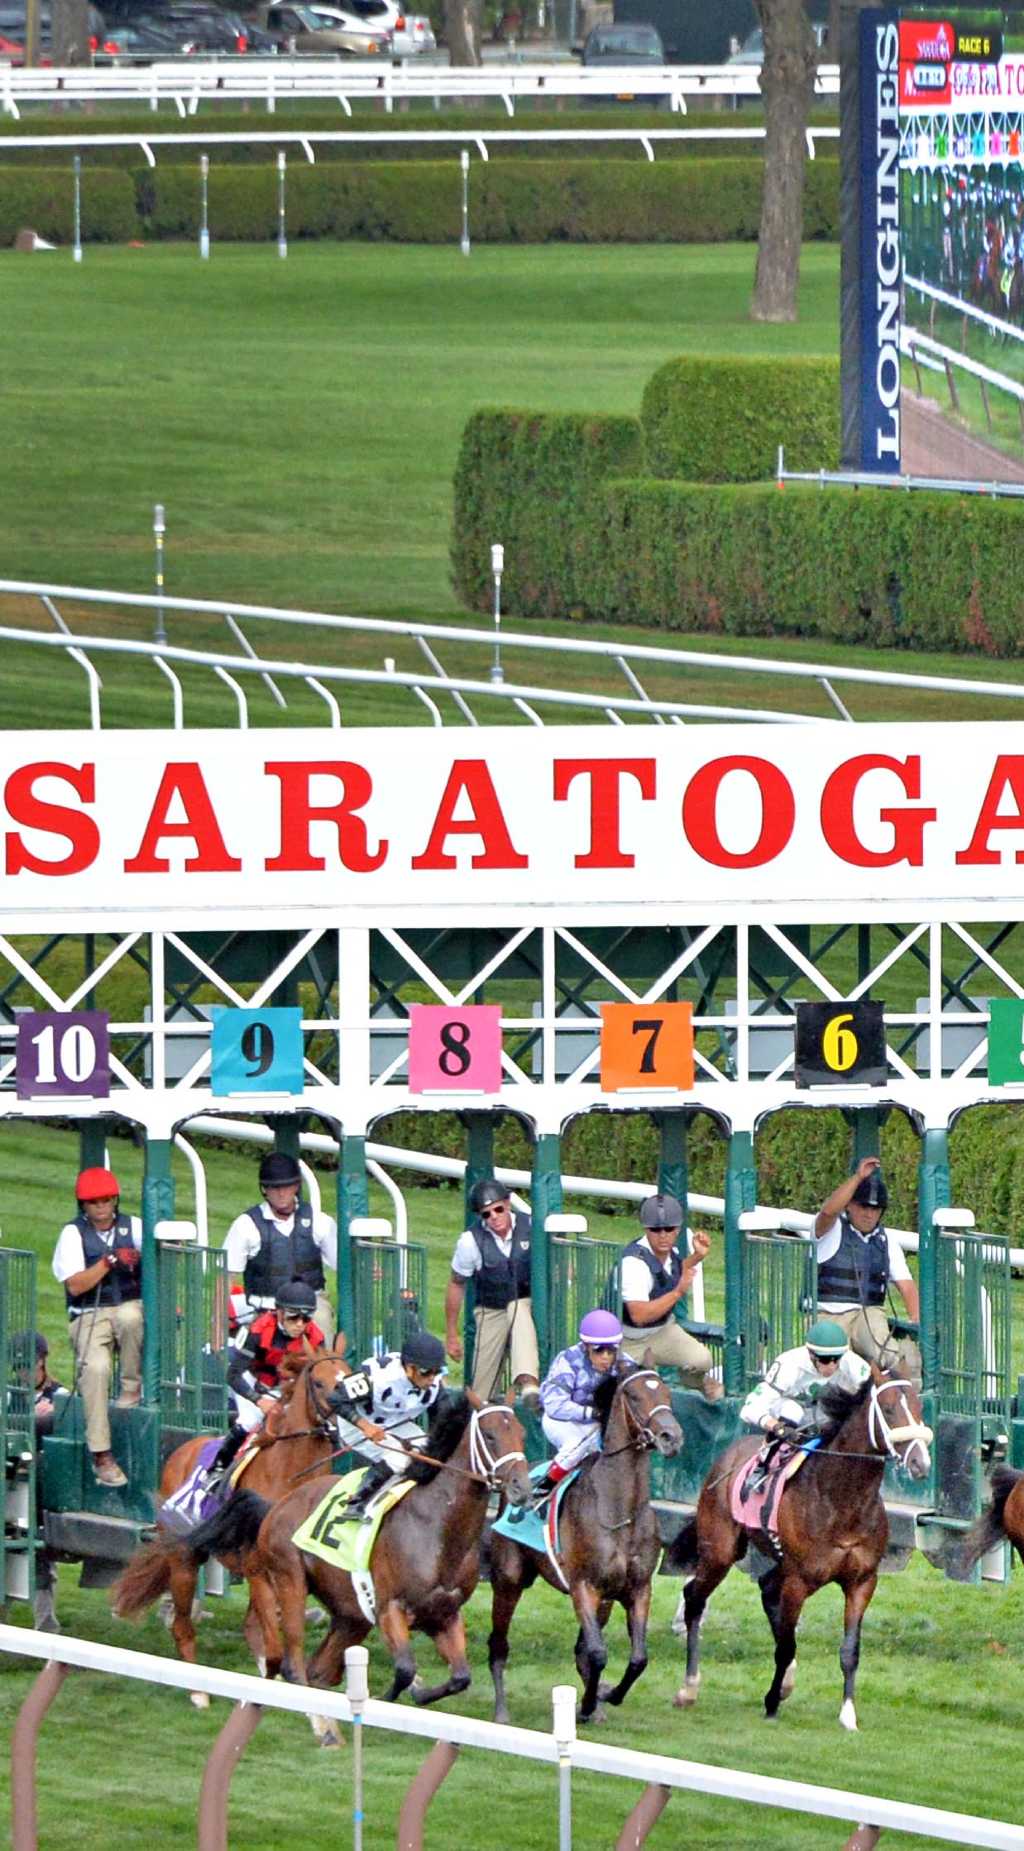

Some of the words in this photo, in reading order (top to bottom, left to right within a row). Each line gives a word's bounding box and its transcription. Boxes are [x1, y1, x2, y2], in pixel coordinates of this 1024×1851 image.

[958, 36, 982, 54] RACE
[876, 23, 899, 460] LONGINES
[32, 1025, 96, 1083] 10
[240, 1022, 274, 1078] 9
[438, 1021, 471, 1076] 8
[632, 1019, 663, 1073] 7
[823, 1013, 858, 1071] 6
[343, 1372, 369, 1399] 12
